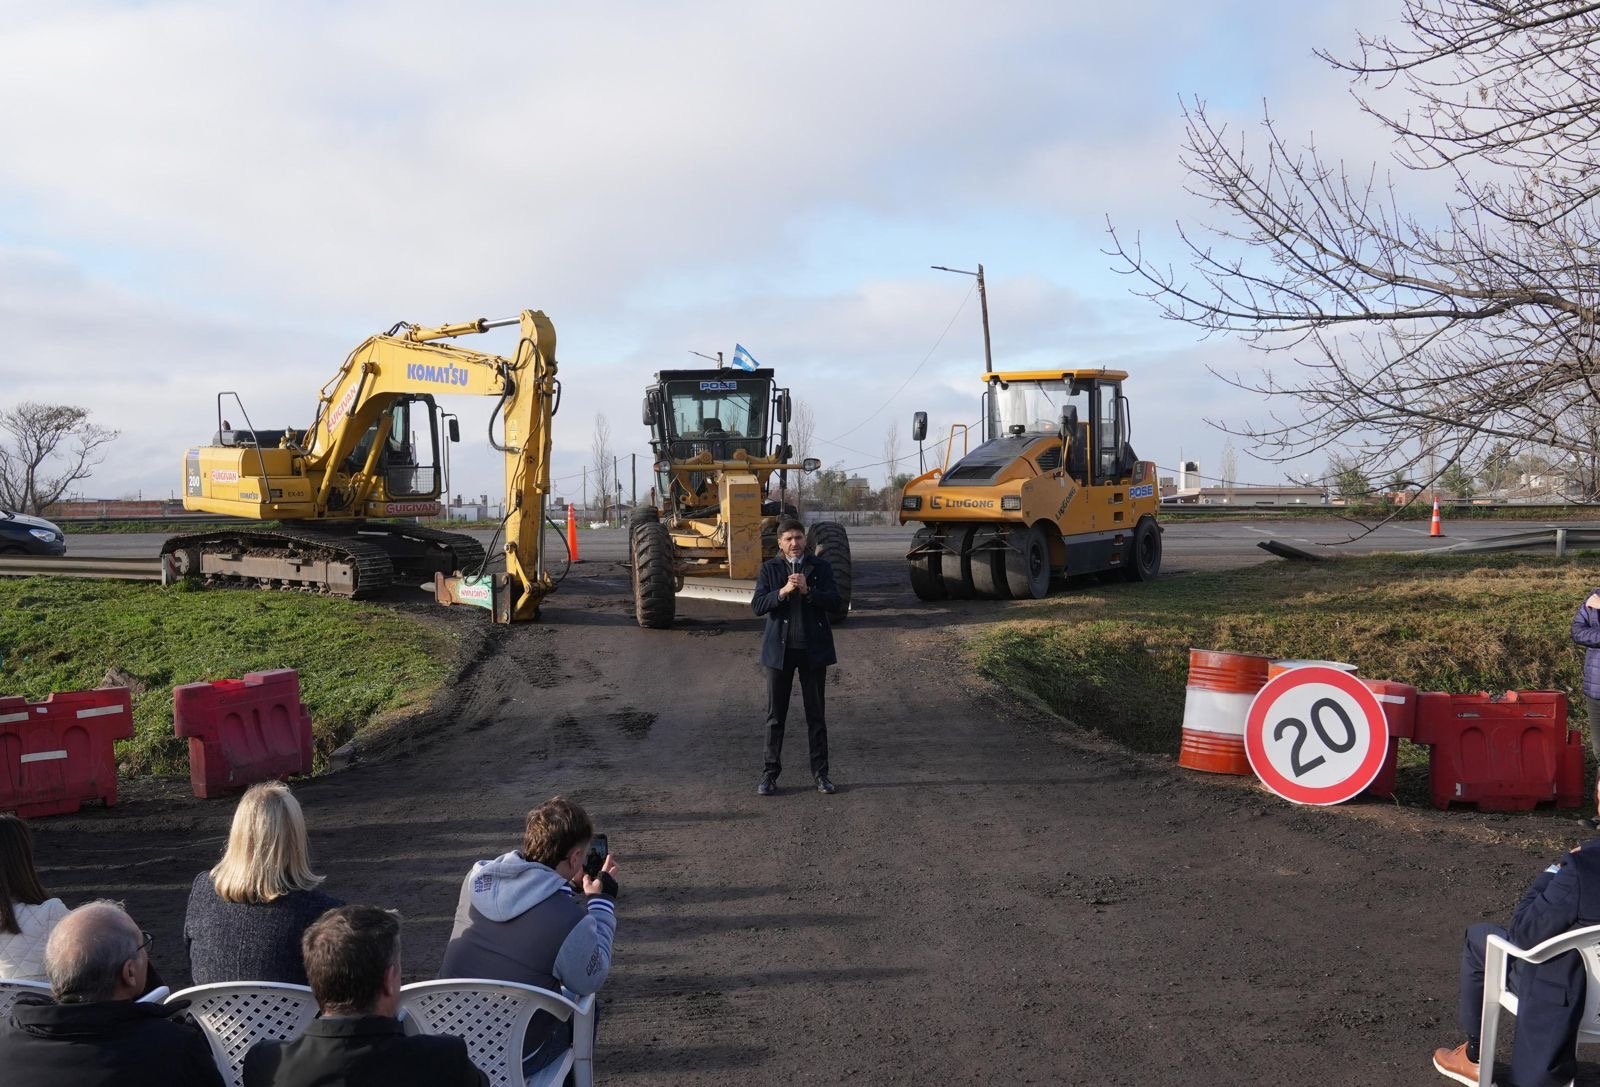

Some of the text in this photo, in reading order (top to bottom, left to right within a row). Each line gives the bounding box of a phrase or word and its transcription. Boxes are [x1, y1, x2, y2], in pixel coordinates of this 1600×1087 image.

[407, 363, 469, 386] KOMATSU
[700, 381, 737, 390] POSE
[188, 475, 200, 487] 200
[1129, 485, 1153, 498] POSE
[386, 503, 436, 514] GUIGIVAN
[1274, 697, 1356, 778] 20
